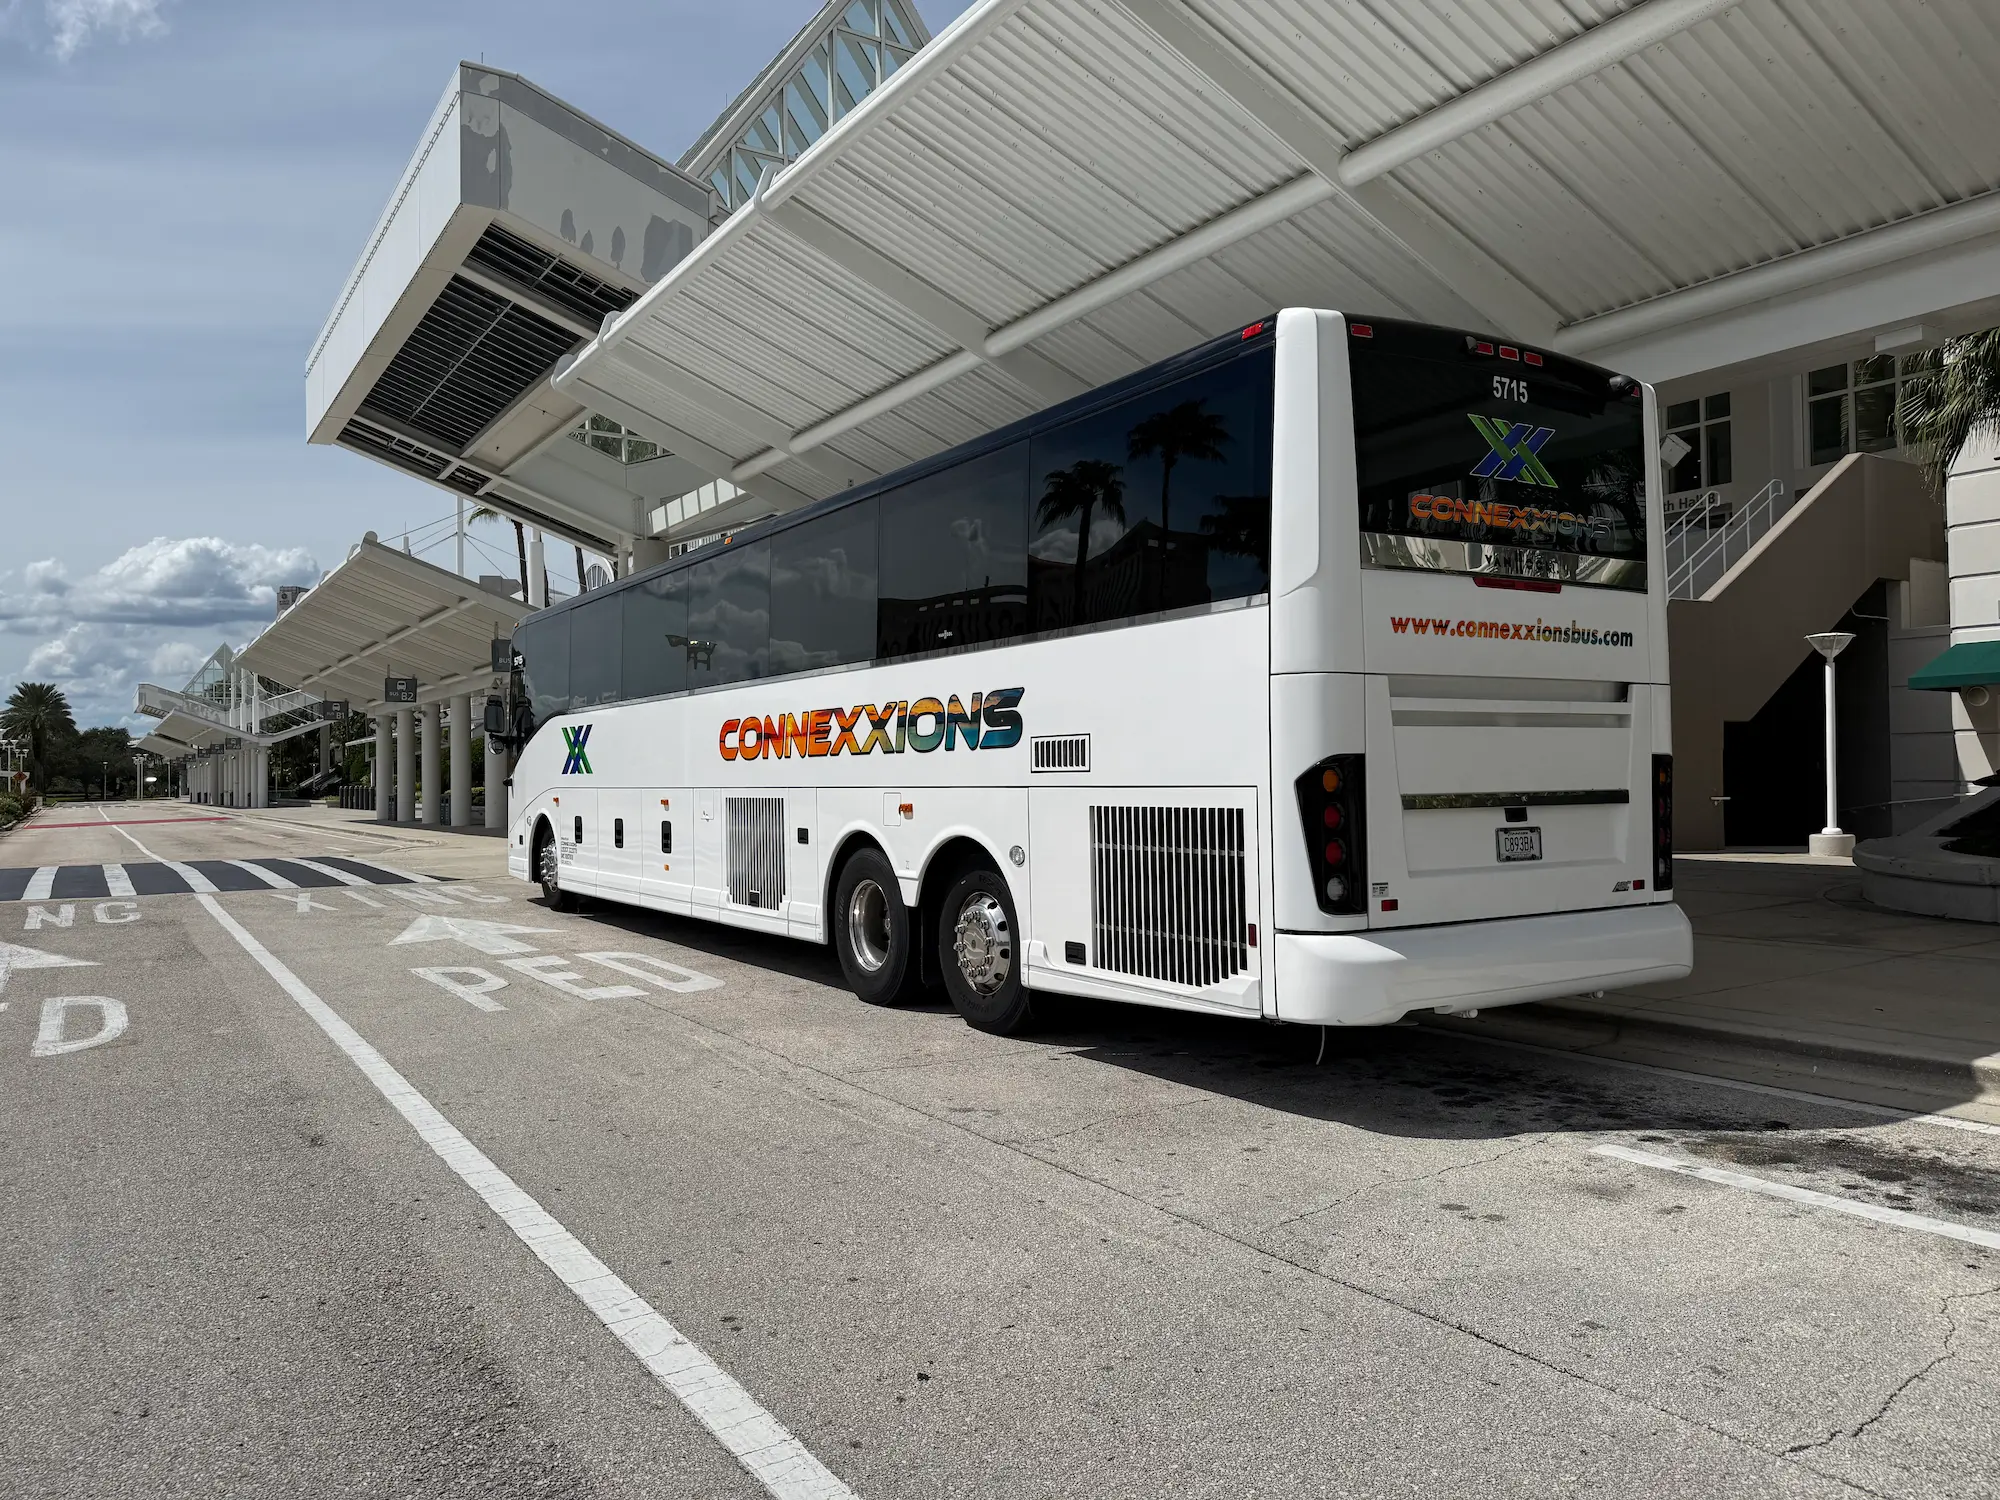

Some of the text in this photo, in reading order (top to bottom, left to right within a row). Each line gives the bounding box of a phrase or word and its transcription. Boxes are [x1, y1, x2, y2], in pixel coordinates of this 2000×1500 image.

[1493, 375, 1528, 404] 5715
[1410, 494, 1611, 540] CONNEXXIONS
[1390, 617, 1633, 648] www.connexxionsbus.com
[401, 692, 414, 701] B2
[719, 687, 1025, 761] CONNEXXIONS
[1504, 836, 1534, 852] C893BA
[269, 886, 513, 913] XING
[24, 902, 142, 929] NG
[408, 951, 726, 1012] PED
[31, 996, 129, 1057] D
